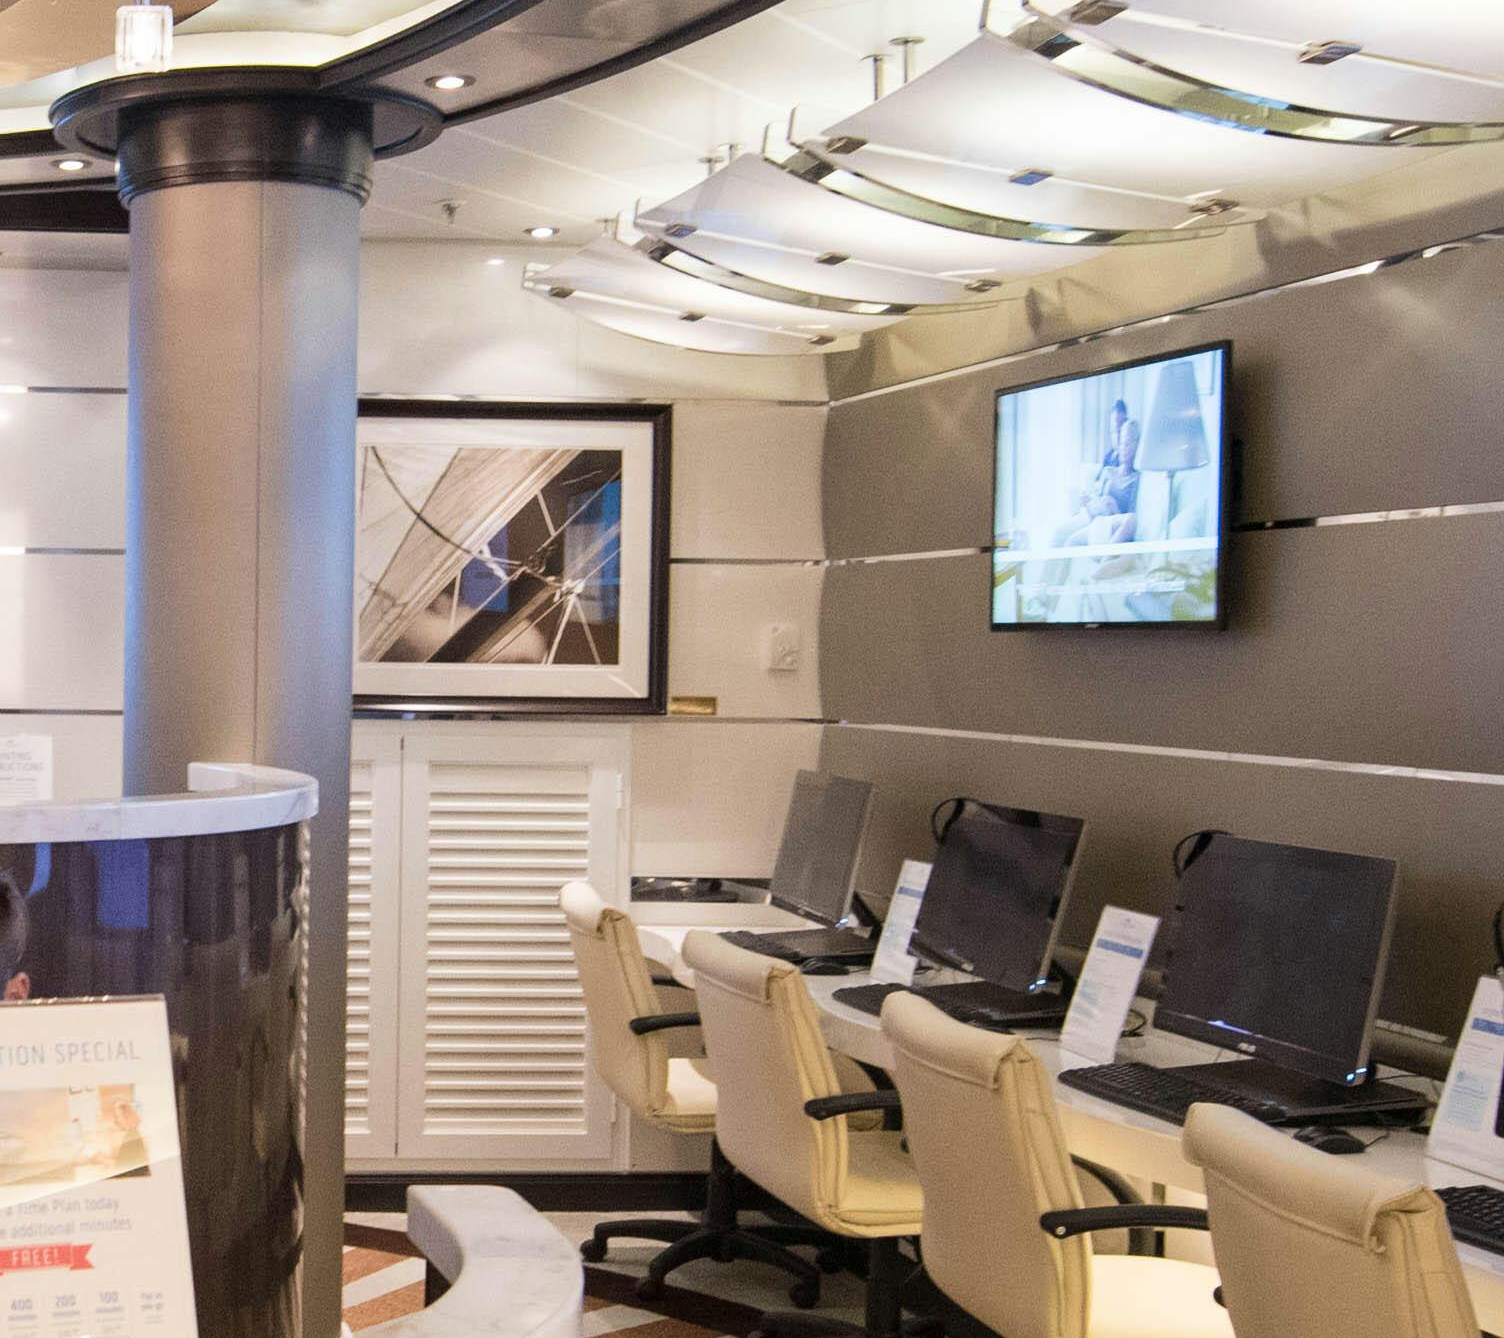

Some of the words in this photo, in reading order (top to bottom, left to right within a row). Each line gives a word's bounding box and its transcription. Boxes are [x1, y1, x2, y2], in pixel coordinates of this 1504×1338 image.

[54, 1040, 141, 1064] SPECIAL
[52, 1198, 81, 1212] Plan
[84, 1197, 119, 1213] today
[11, 1248, 59, 1266] FREE!
[9, 1298, 33, 1311] 400
[54, 1294, 76, 1309] 200
[97, 1291, 119, 1304] 100
